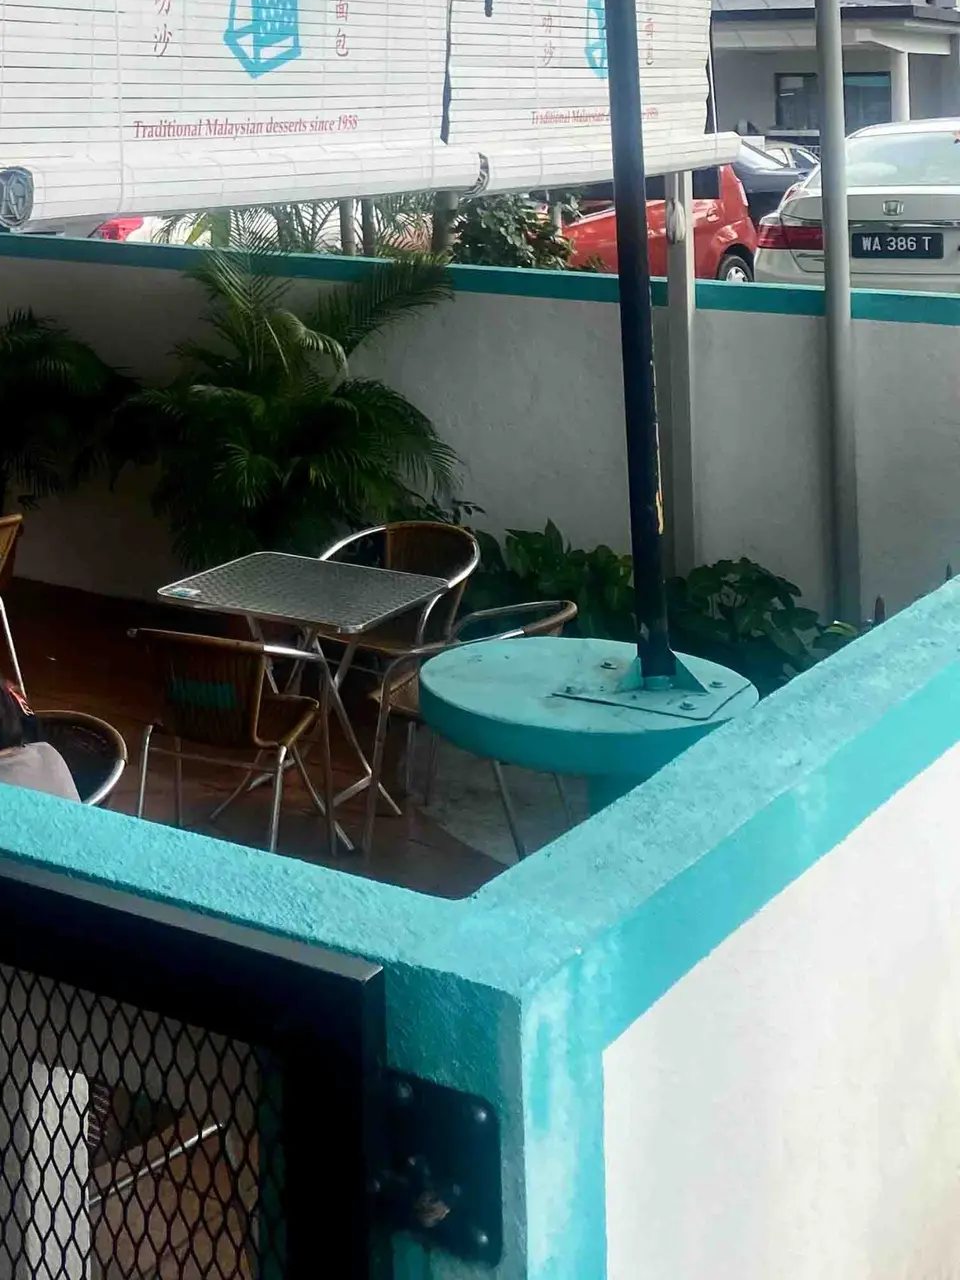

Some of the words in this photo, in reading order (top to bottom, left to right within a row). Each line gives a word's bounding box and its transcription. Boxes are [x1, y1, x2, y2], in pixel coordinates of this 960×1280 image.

[133, 118, 202, 139] Traditional
[205, 117, 264, 140] Malaysian
[265, 117, 307, 133] desserts
[309, 116, 335, 132] since
[337, 114, 358, 131] 1958
[862, 237, 881, 251] WA
[887, 237, 916, 251] 386
[922, 237, 932, 251] T
